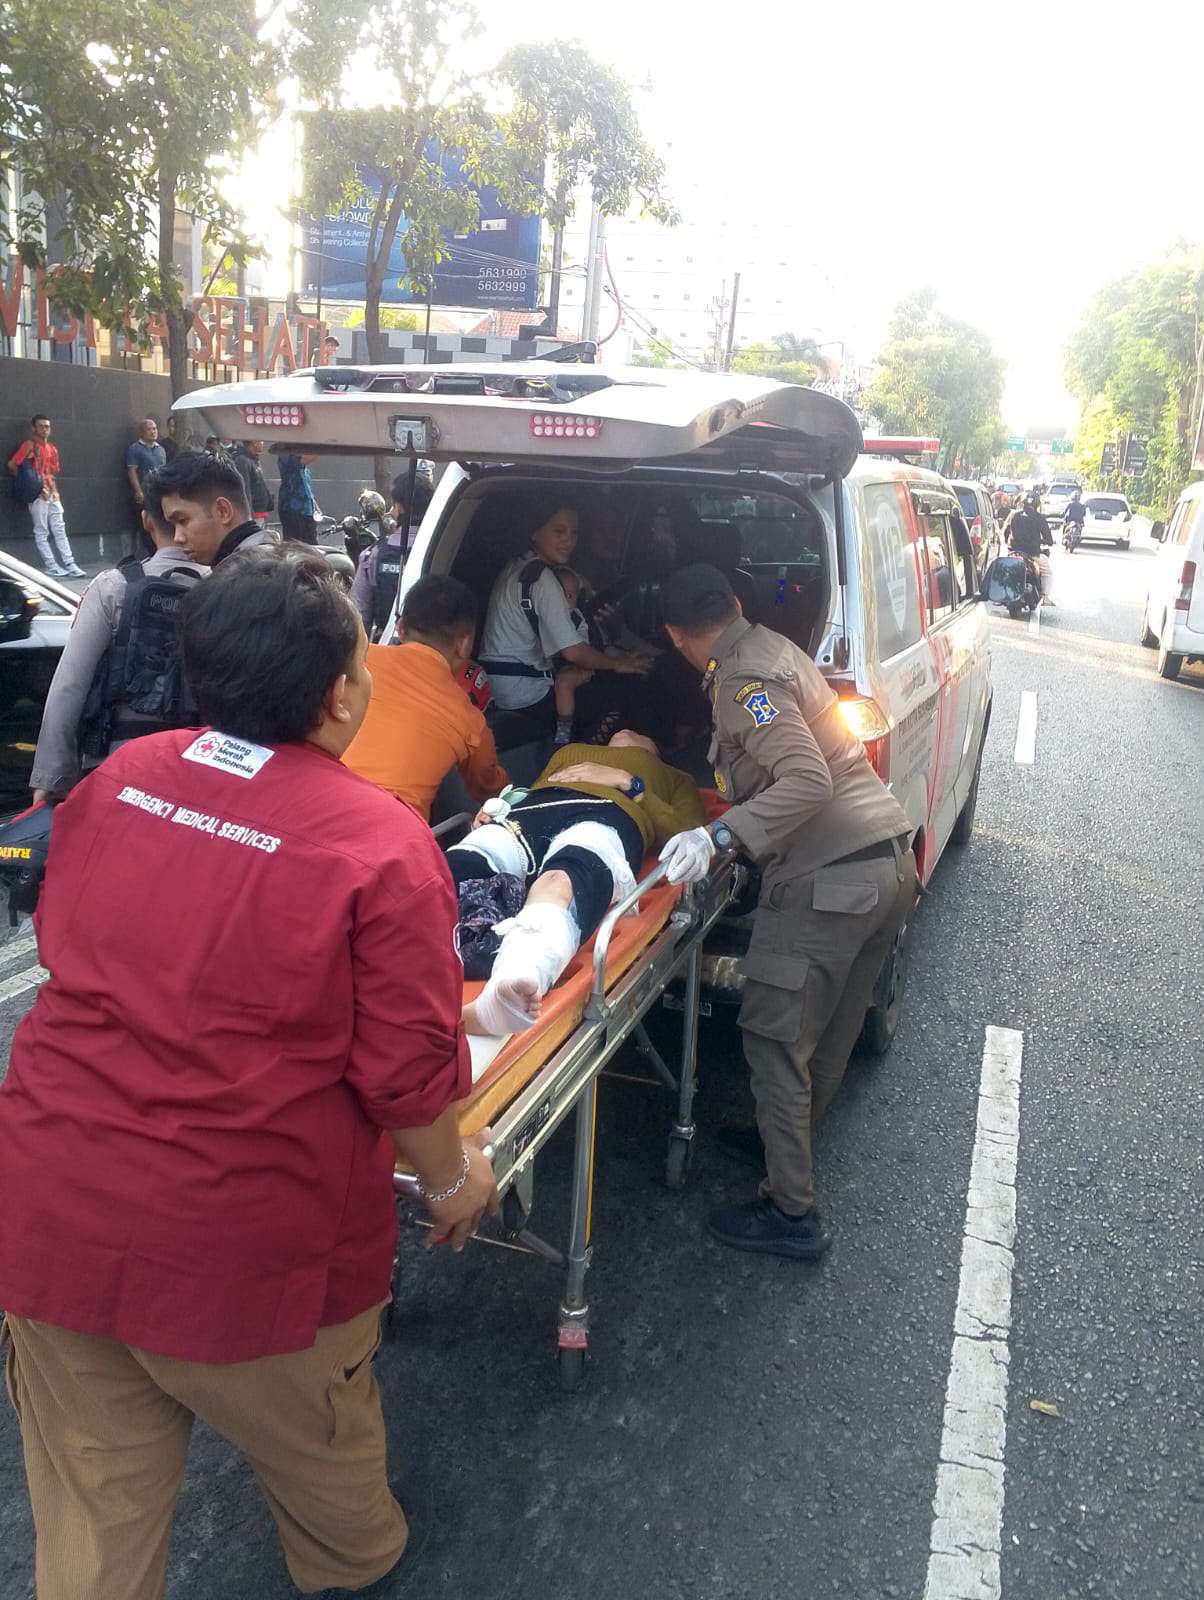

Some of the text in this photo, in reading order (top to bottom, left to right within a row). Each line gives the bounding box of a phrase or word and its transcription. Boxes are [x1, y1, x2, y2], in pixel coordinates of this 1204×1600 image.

[478, 280, 526, 292] 5632999
[217, 747, 244, 761] Merah
[223, 739, 252, 756] Palang
[116, 786, 281, 853] EMERGENCY MEDICAL SERVICES
